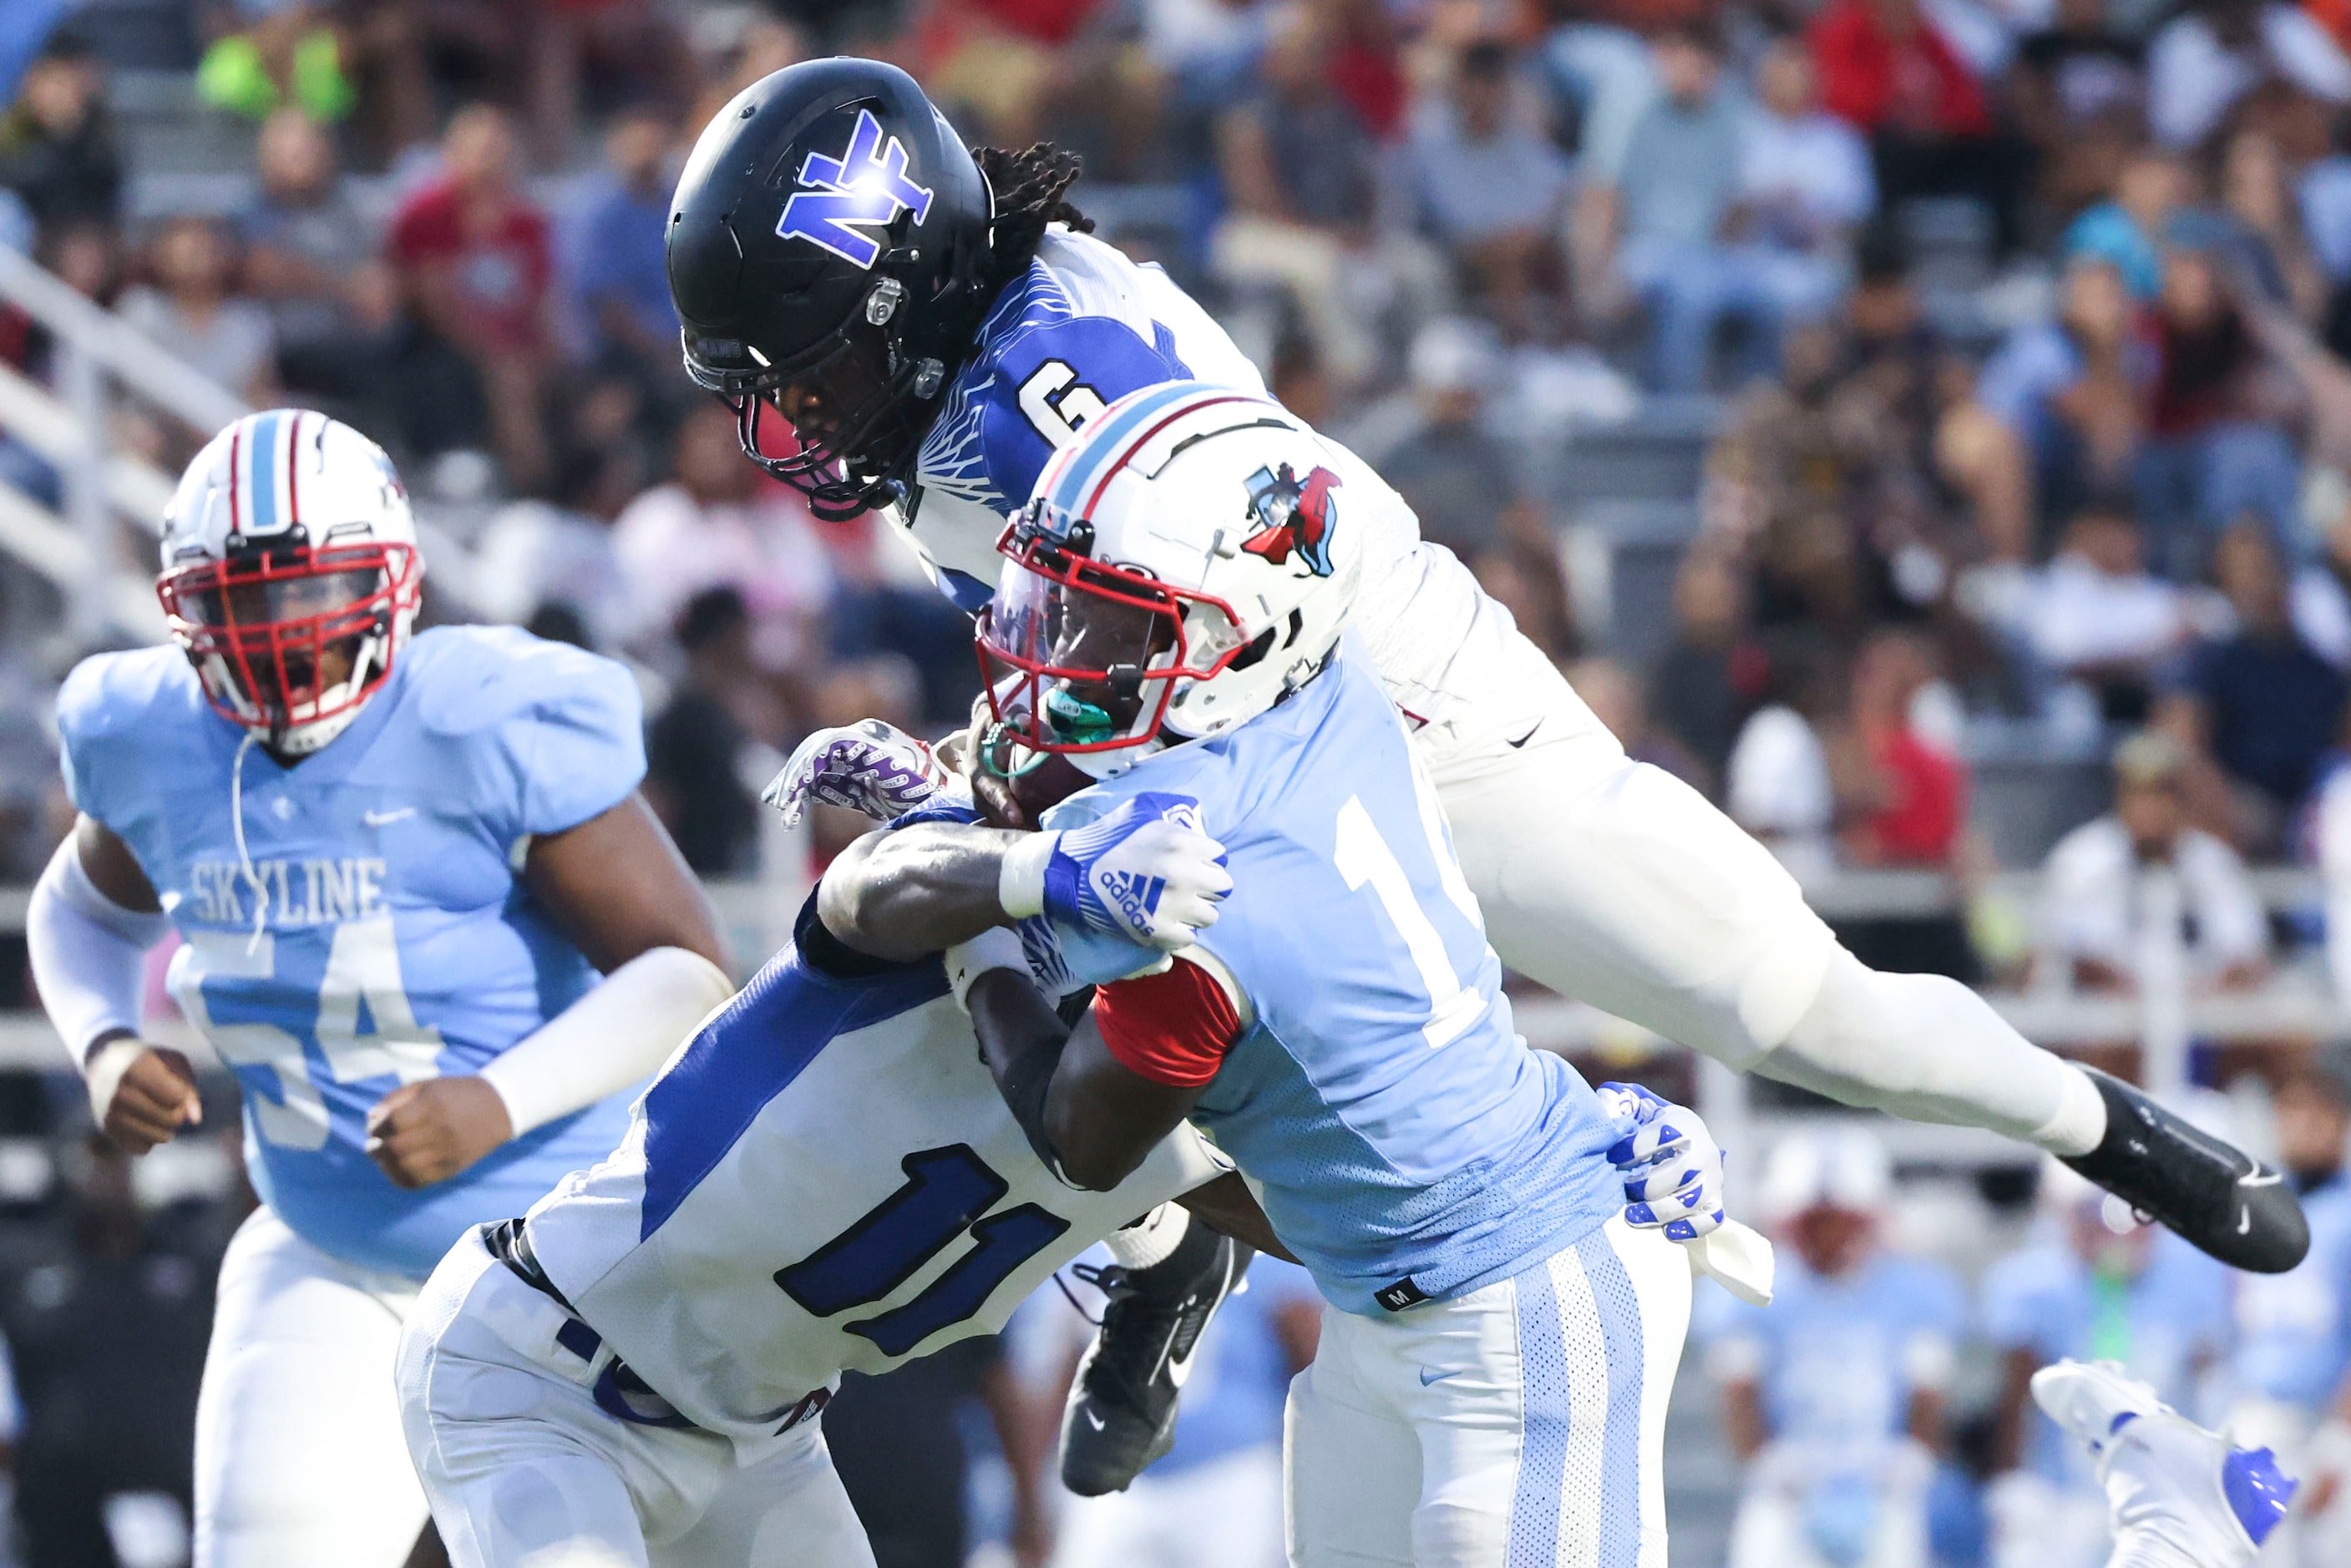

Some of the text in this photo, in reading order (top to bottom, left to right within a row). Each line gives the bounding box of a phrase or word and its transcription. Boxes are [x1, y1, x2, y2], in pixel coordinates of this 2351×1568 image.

[776, 109, 934, 271] NF
[190, 857, 388, 924] SKYLINE
[1101, 872, 1155, 936] adidas
[166, 915, 446, 1151] 54
[773, 1141, 1072, 1358] 11
[1387, 1289, 1411, 1306] M
